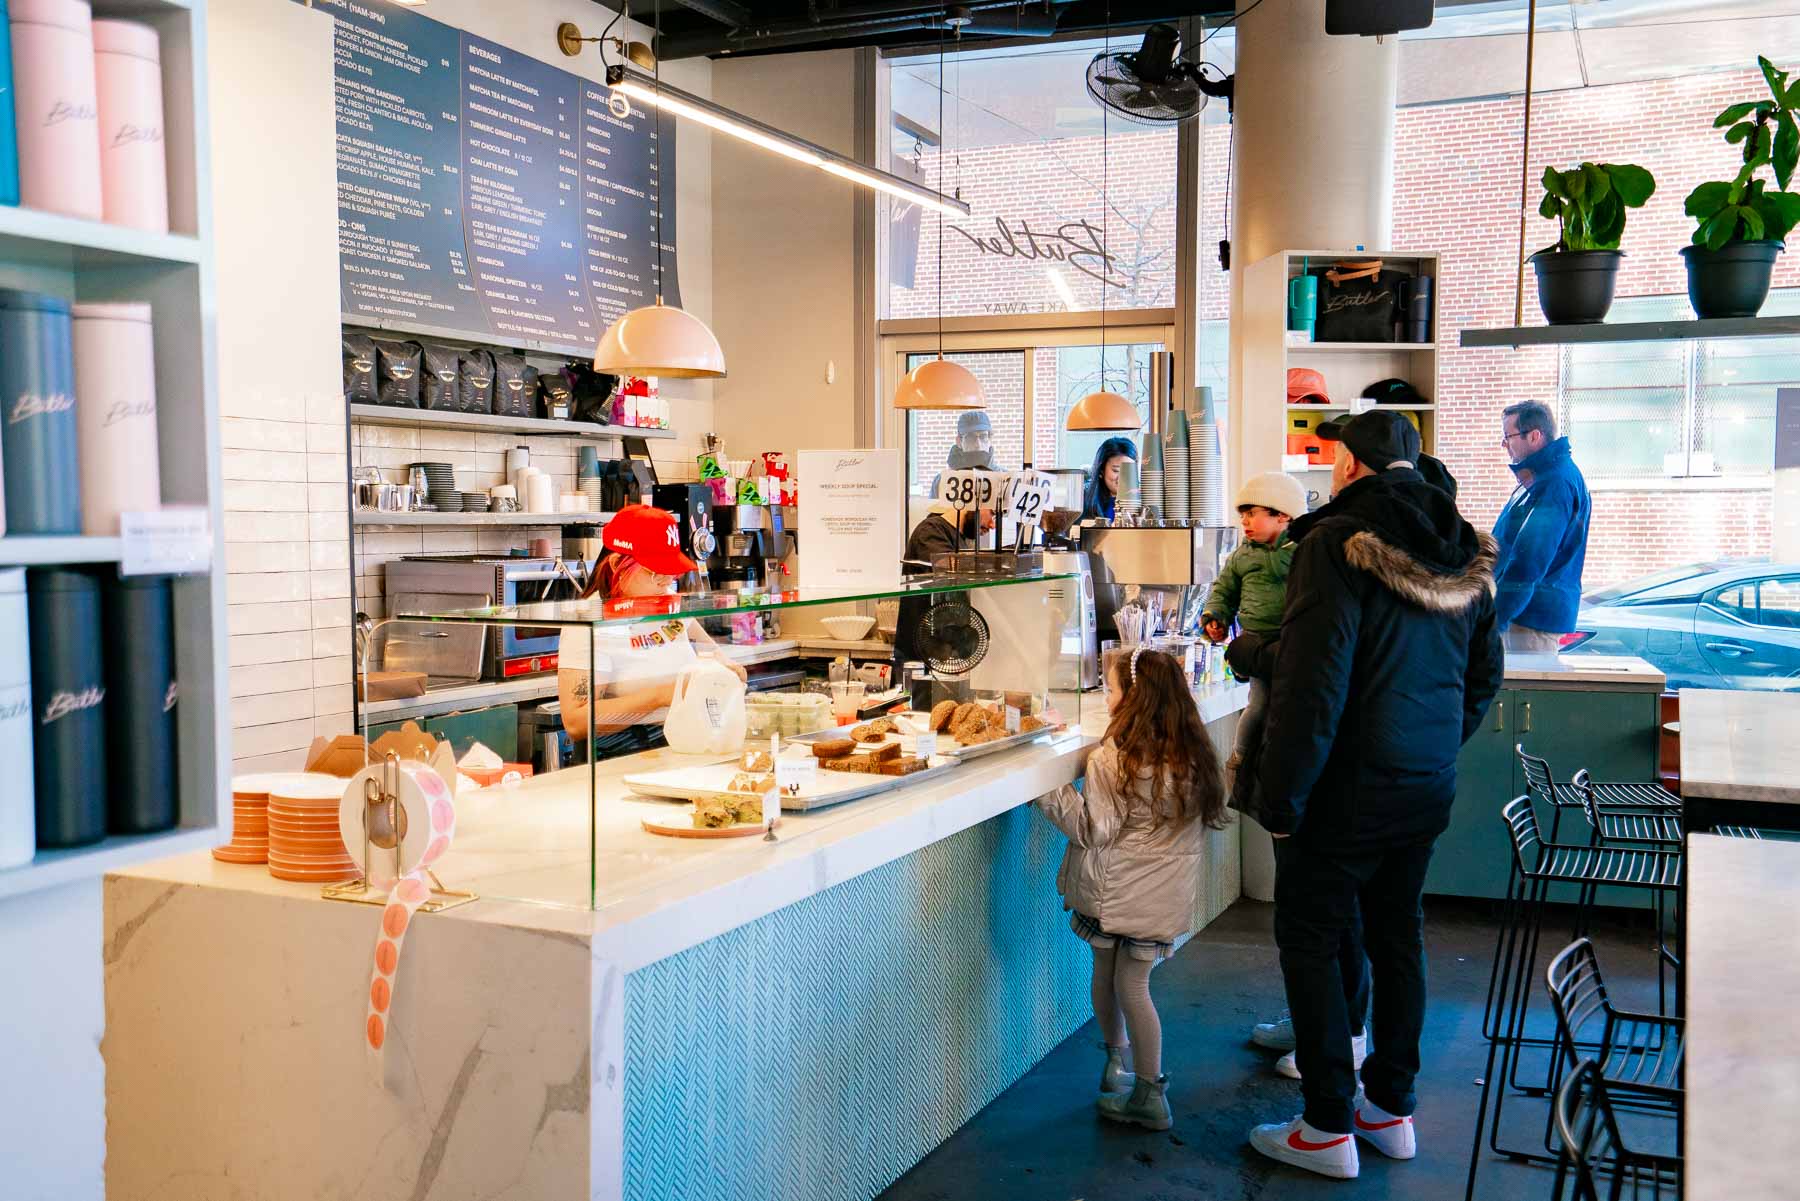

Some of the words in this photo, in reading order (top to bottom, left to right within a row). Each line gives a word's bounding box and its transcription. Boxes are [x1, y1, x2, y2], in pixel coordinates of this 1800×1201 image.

[355, 26, 379, 40] CHICKEN
[379, 35, 408, 51] SANDWICH
[364, 48, 382, 60] ONION
[404, 63, 421, 74] HOUSE
[468, 43, 501, 64] BEVERAGES
[469, 63, 490, 78] MATCHA
[490, 72, 505, 84] LATTE
[350, 91, 364, 100] PORK
[366, 96, 379, 105] WITH
[360, 85, 375, 95] PORK
[376, 90, 404, 105] SANDWICH
[469, 82, 490, 96] MATCHA
[490, 90, 500, 100] TEA
[586, 89, 604, 103] COFFEE
[348, 99, 364, 109] FRESH
[469, 100, 498, 117] MUSHROOM
[499, 111, 513, 123] LATTE
[352, 137, 374, 150] SQUASH
[375, 144, 392, 155] SALAD
[495, 128, 512, 140] GINGER
[512, 134, 526, 145] LATTE
[470, 138, 479, 147] HOT
[480, 141, 509, 157] CHOCOLATE
[483, 161, 497, 170] LATTE
[354, 185, 392, 201] CAULIFLOWER
[393, 195, 409, 206] WRAP
[1323, 289, 1390, 314] Butler
[946, 477, 974, 503] 38
[1016, 491, 1041, 518] 42
[613, 538, 633, 550] MoMA
